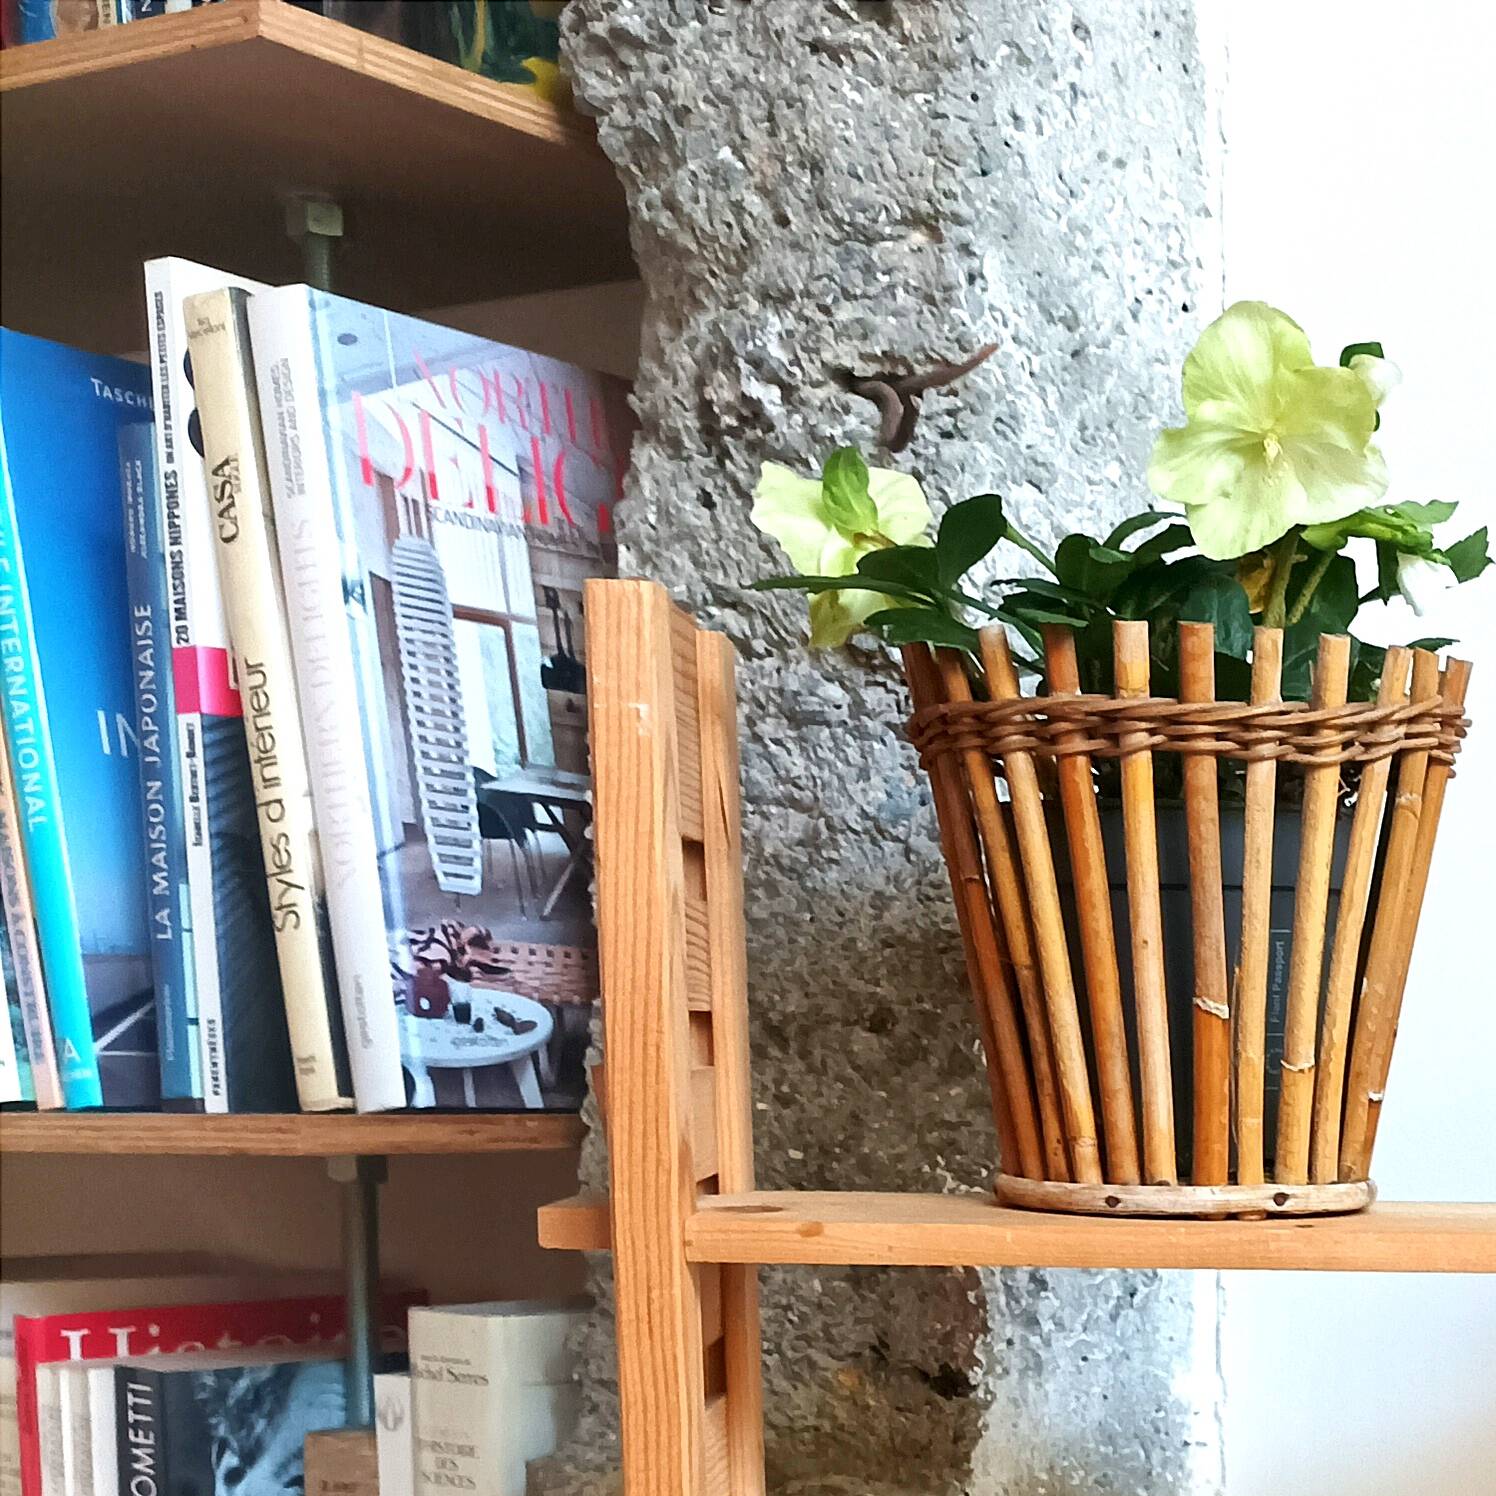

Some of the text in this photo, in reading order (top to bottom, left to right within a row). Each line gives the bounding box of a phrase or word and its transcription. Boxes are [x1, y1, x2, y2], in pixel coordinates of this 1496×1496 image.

[211, 456, 240, 544] CASA
[169, 549, 188, 622] MAISONS
[175, 625, 190, 646] 20
[0, 583, 48, 833] INTERNATIONAL
[134, 603, 173, 941] LA MAISON JAPONAISE
[266, 831, 305, 934] Styles
